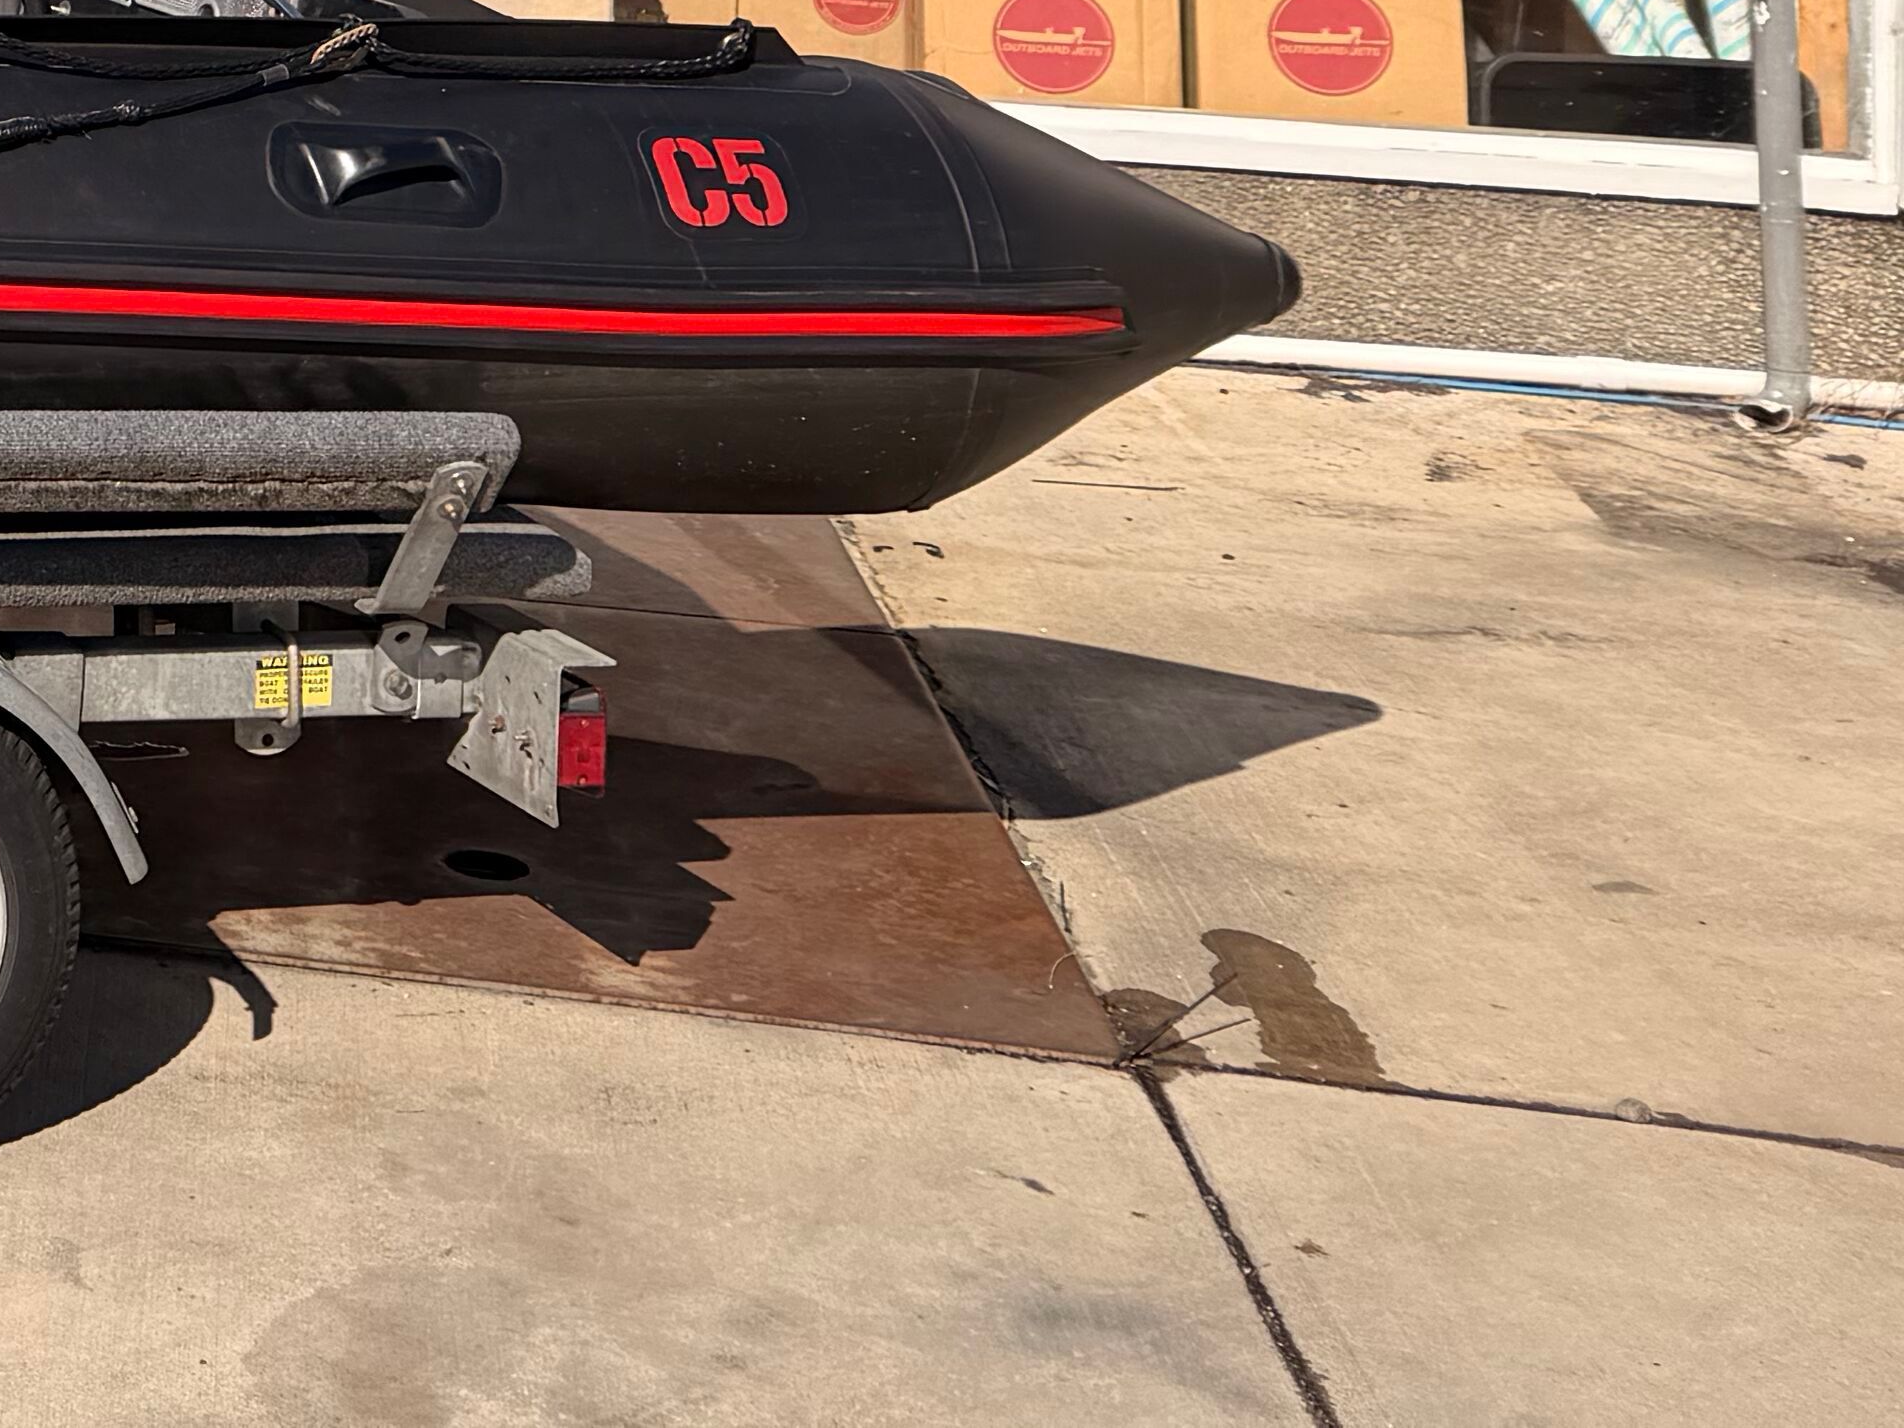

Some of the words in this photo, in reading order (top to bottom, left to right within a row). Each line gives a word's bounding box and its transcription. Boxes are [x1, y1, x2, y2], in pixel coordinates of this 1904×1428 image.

[1002, 42, 1070, 54] OUTBOARD
[1071, 46, 1103, 57] JETS
[1278, 43, 1349, 55] OUTBOARD
[1349, 46, 1381, 57] JETS
[650, 135, 789, 228] C5
